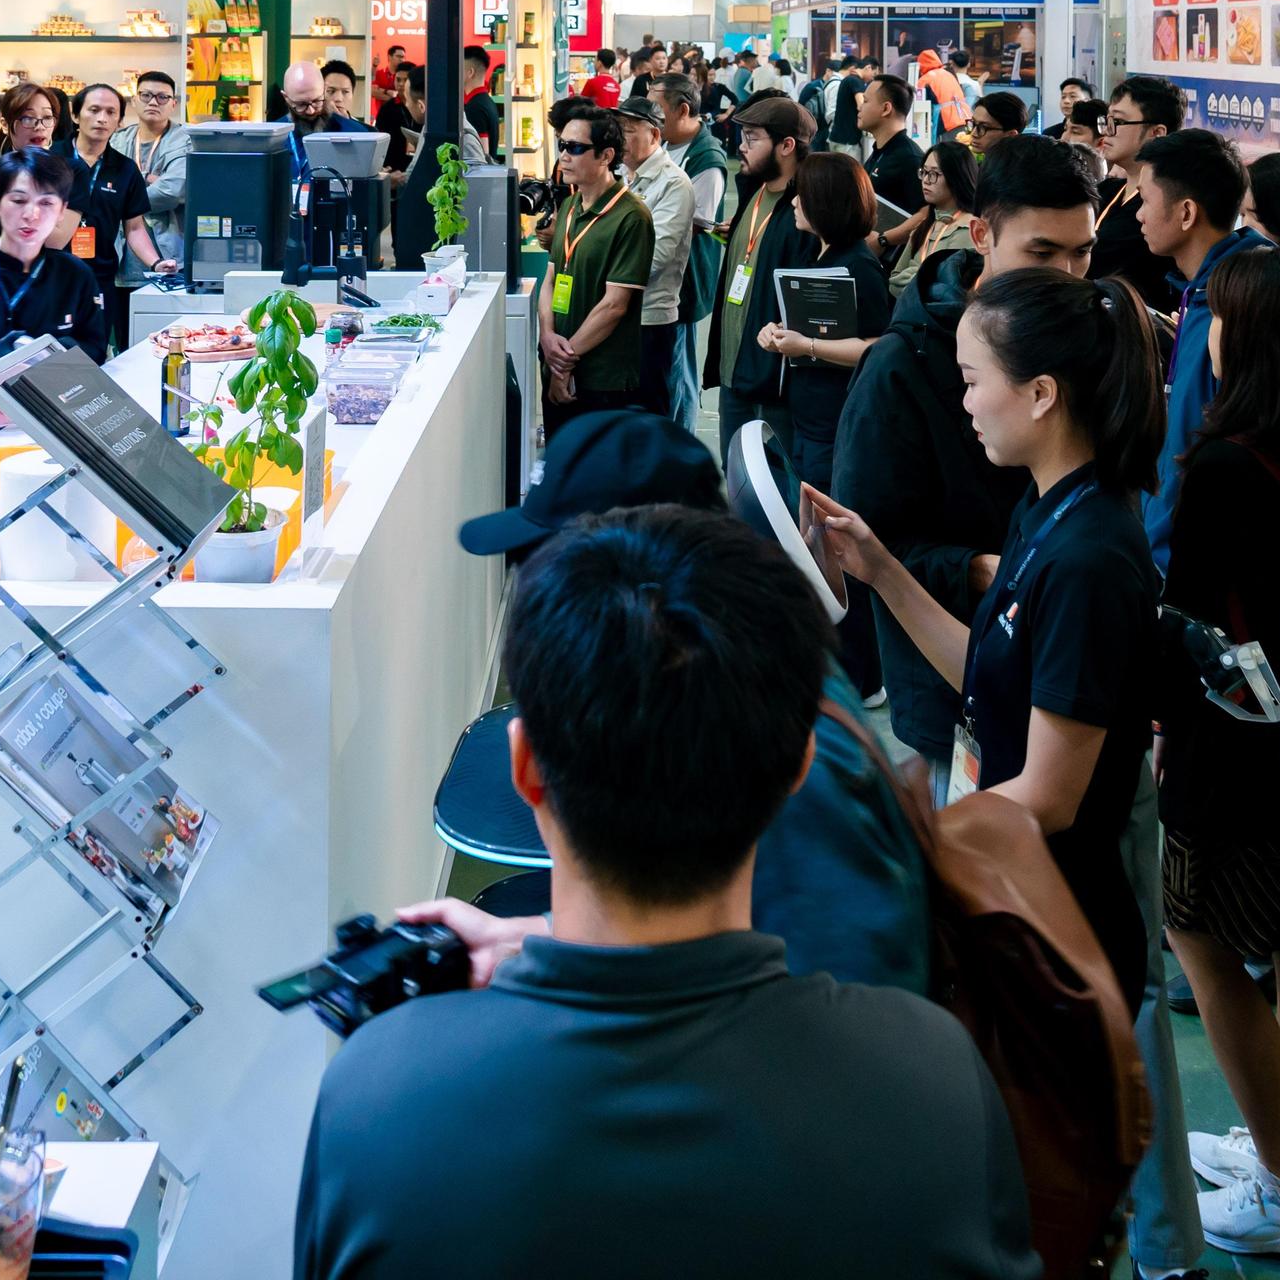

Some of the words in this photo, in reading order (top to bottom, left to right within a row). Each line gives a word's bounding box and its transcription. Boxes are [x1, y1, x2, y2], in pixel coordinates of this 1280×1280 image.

[73, 392, 113, 420] INNOVATIVE
[113, 427, 147, 456] SOLUTIONS
[13, 720, 39, 751] robot
[39, 685, 69, 720] coupe
